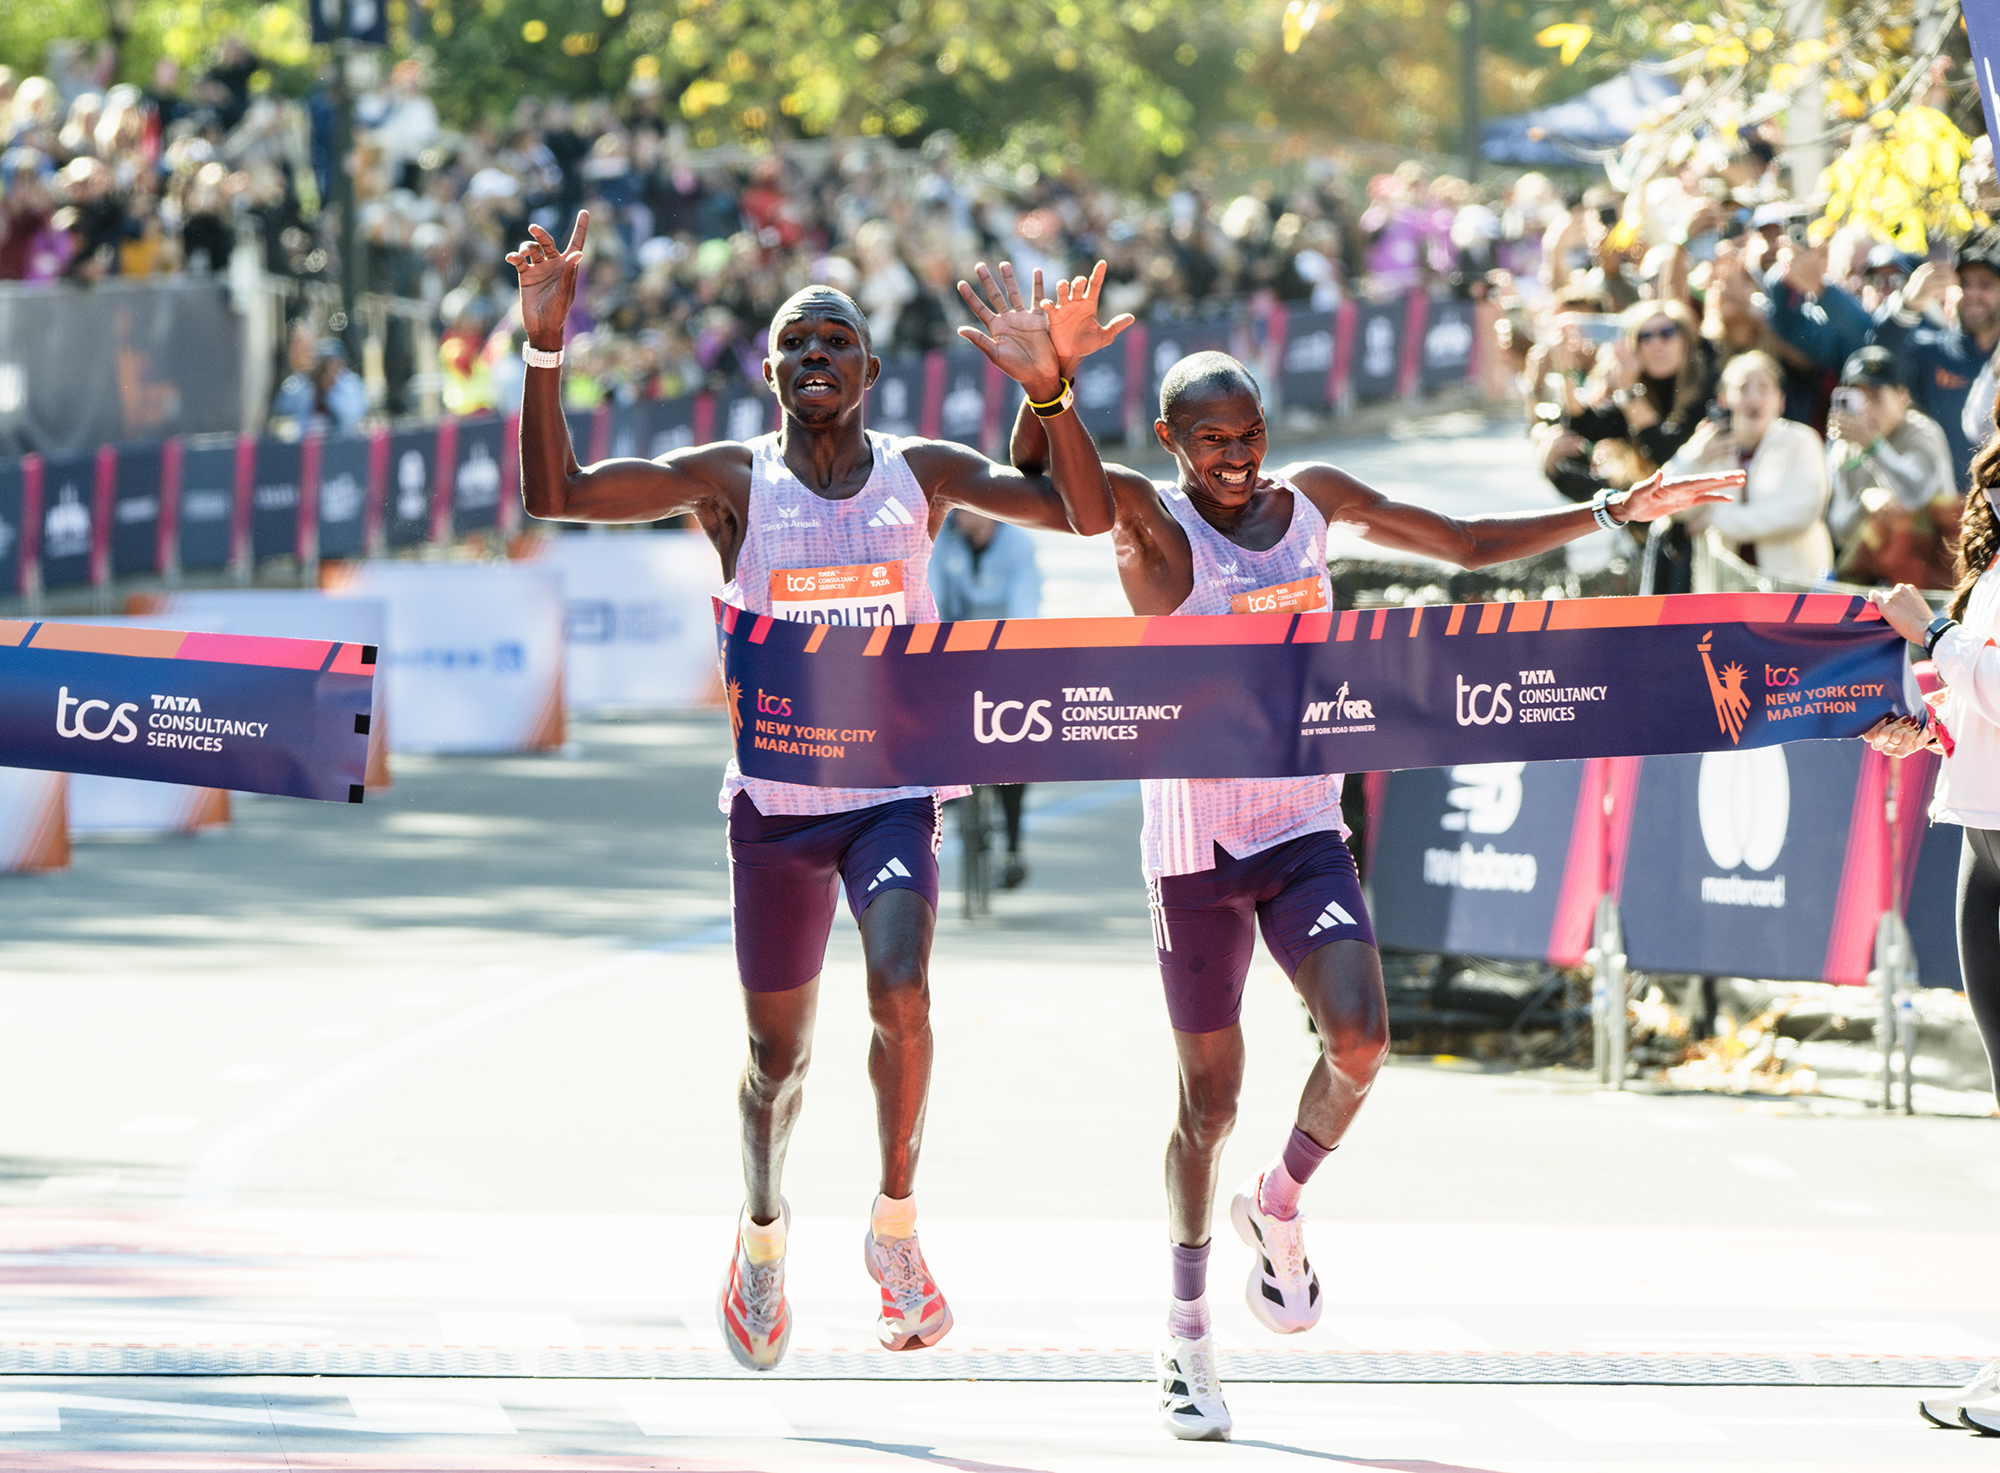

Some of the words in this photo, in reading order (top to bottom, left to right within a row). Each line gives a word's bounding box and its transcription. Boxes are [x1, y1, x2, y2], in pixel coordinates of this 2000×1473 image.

[761, 520, 789, 533] Tirop's
[790, 519, 820, 529] Angels
[787, 574, 816, 592] tcs
[818, 576, 860, 584] CONSULTANCY
[870, 579, 890, 587] TATA
[1247, 594, 1277, 613] tcs
[1277, 590, 1308, 601] CONSULTANCY
[1278, 599, 1298, 608] SERVICES
[1518, 669, 1556, 685] TATA
[1764, 663, 1800, 687] tcs
[151, 694, 202, 713] TATA
[757, 688, 792, 717] tcs
[1061, 687, 1114, 702] TATA
[1456, 674, 1513, 726] tcs
[1518, 686, 1608, 704] CONSULTANCY
[1765, 691, 1802, 706] NEW
[1804, 685, 1848, 700] YORK
[1849, 683, 1885, 698] CITY
[56, 686, 139, 743] tcs
[973, 690, 1053, 744] tcs
[1061, 705, 1183, 722] CONSULTANCY
[1519, 707, 1576, 723] SERVICES
[1766, 701, 1857, 722] MARATHON
[148, 713, 269, 738] CONSULTANCY
[755, 719, 792, 737] NEW
[793, 725, 838, 741] YORK
[840, 729, 877, 743] CITY
[1061, 725, 1138, 742] SERVICES
[1301, 728, 1315, 736] NEW
[1315, 727, 1332, 735] YORK
[1331, 726, 1349, 734] ROAD
[1348, 724, 1377, 733] RUNNERS
[146, 731, 223, 753] SERVICES
[754, 735, 845, 759] MARATHON
